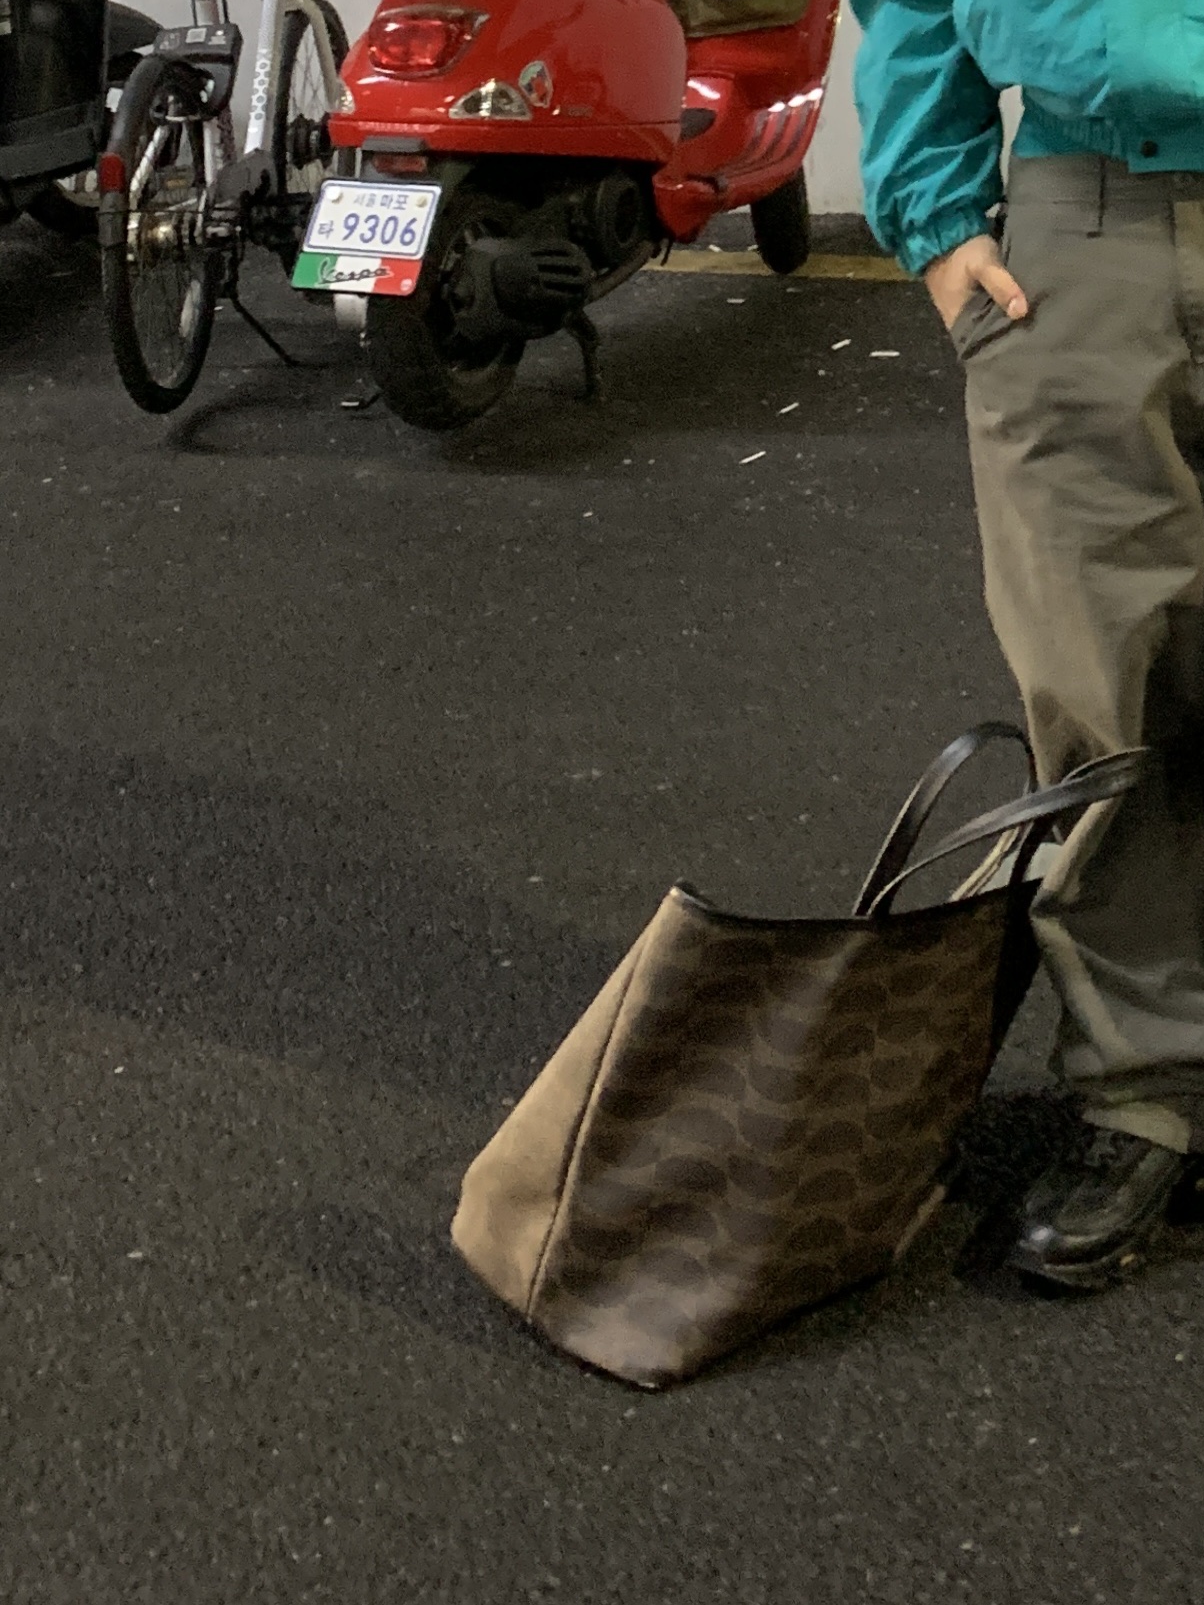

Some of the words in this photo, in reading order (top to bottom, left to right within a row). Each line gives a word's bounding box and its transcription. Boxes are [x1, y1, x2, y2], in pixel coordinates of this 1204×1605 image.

[353, 193, 409, 211] 서울마포
[342, 213, 417, 246] 9306
[315, 257, 394, 288] Vespa
